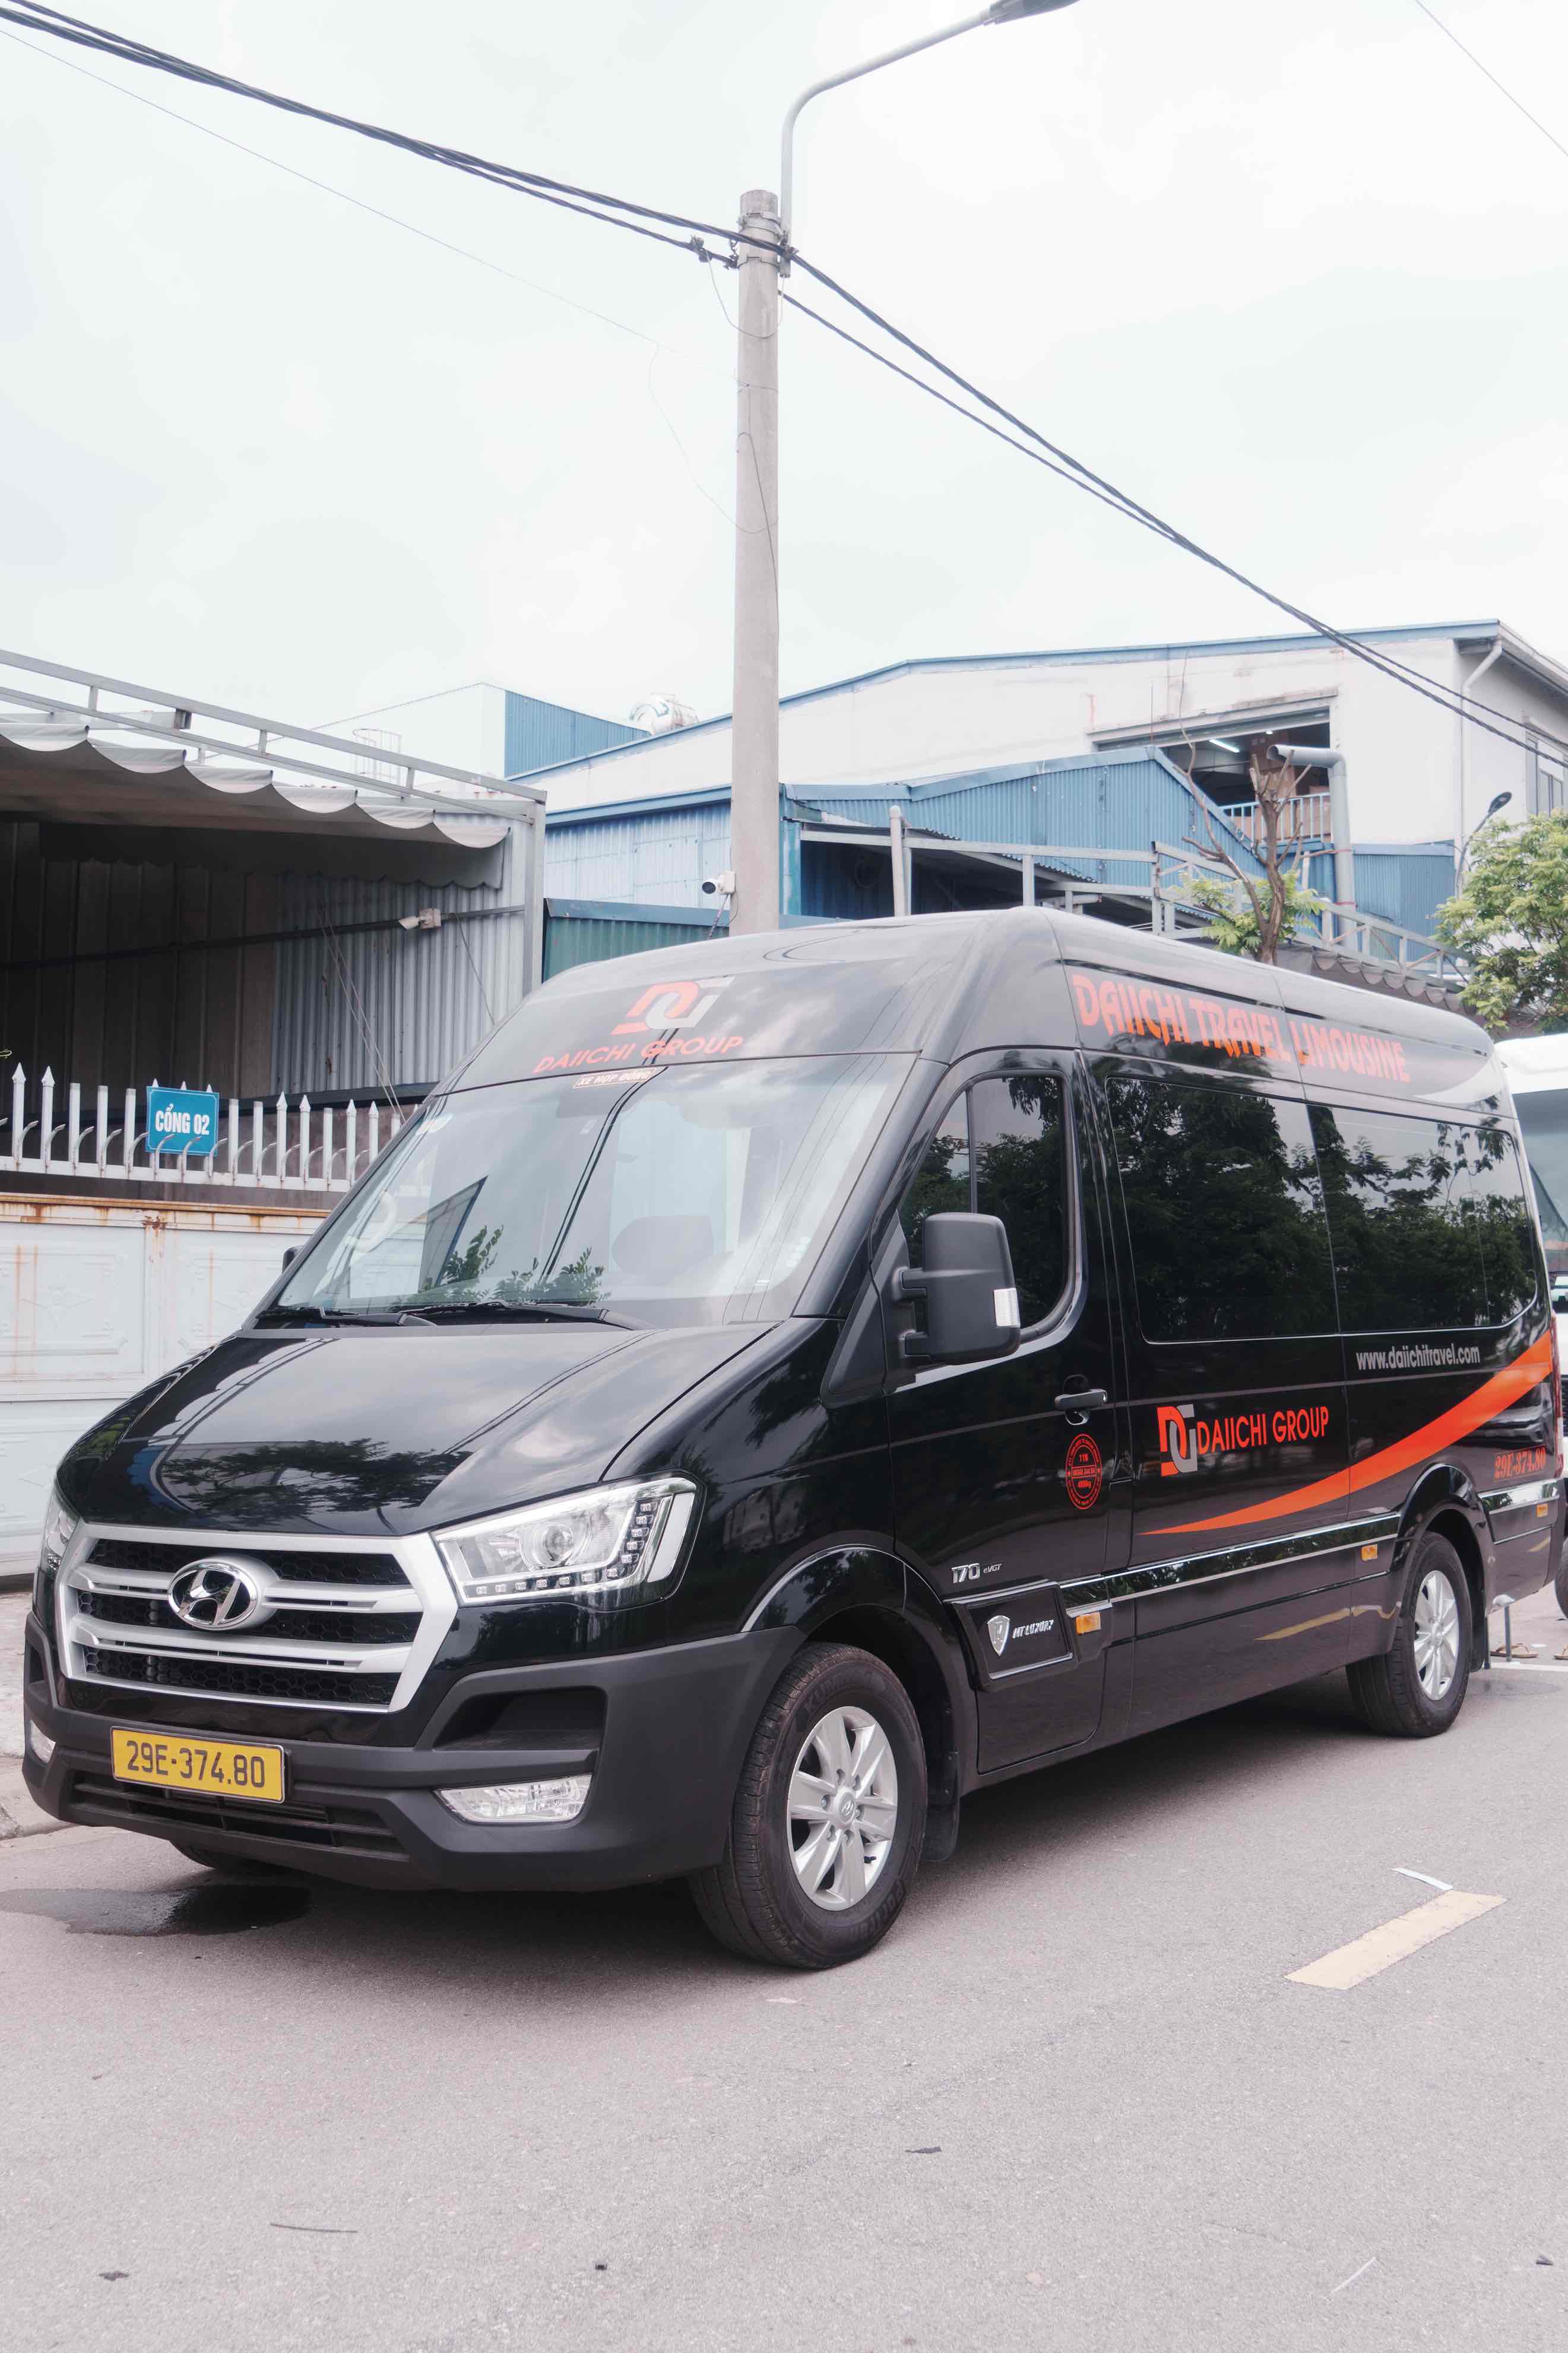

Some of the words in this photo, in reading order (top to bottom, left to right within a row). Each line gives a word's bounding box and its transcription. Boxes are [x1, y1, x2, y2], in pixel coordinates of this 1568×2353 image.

[1073, 973, 1192, 1046] DAIICHI
[1189, 997, 1293, 1063] TRAVEL
[1288, 1020, 1411, 1083] LIMOUSINE
[533, 1043, 636, 1074] DAIICHI
[641, 1036, 743, 1059] GROUP
[155, 1103, 190, 1134] CỔNG
[194, 1114, 210, 1135] 02
[1355, 1343, 1481, 1370] www.daiichitravel.com
[1196, 1413, 1268, 1455] DAIICHI
[1272, 1406, 1329, 1443] GROUP
[951, 1563, 980, 1584] 170
[126, 1740, 265, 1788] 29E-374.80
